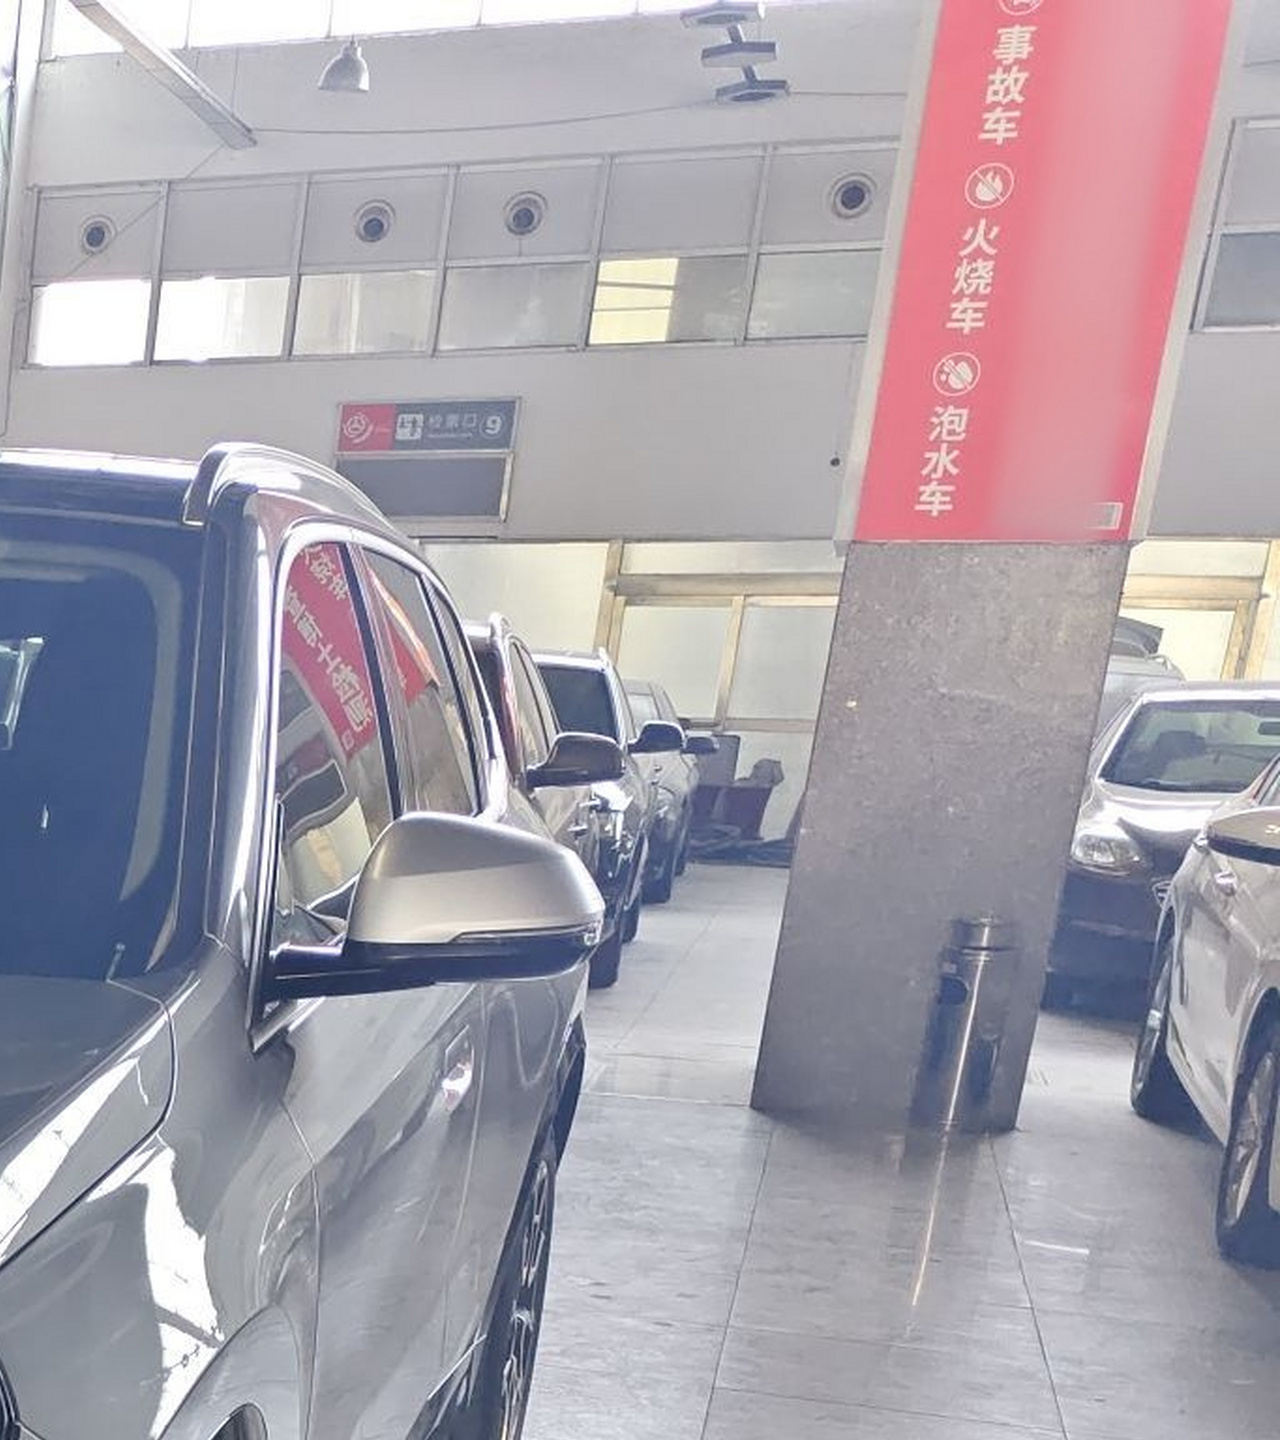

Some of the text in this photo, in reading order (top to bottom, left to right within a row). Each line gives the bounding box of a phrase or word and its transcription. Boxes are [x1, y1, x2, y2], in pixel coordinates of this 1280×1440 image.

[978, 23, 1038, 146] 事故车
[945, 217, 1000, 336] 火烧车
[485, 415, 503, 435] 9
[914, 404, 970, 518] 泡水车
